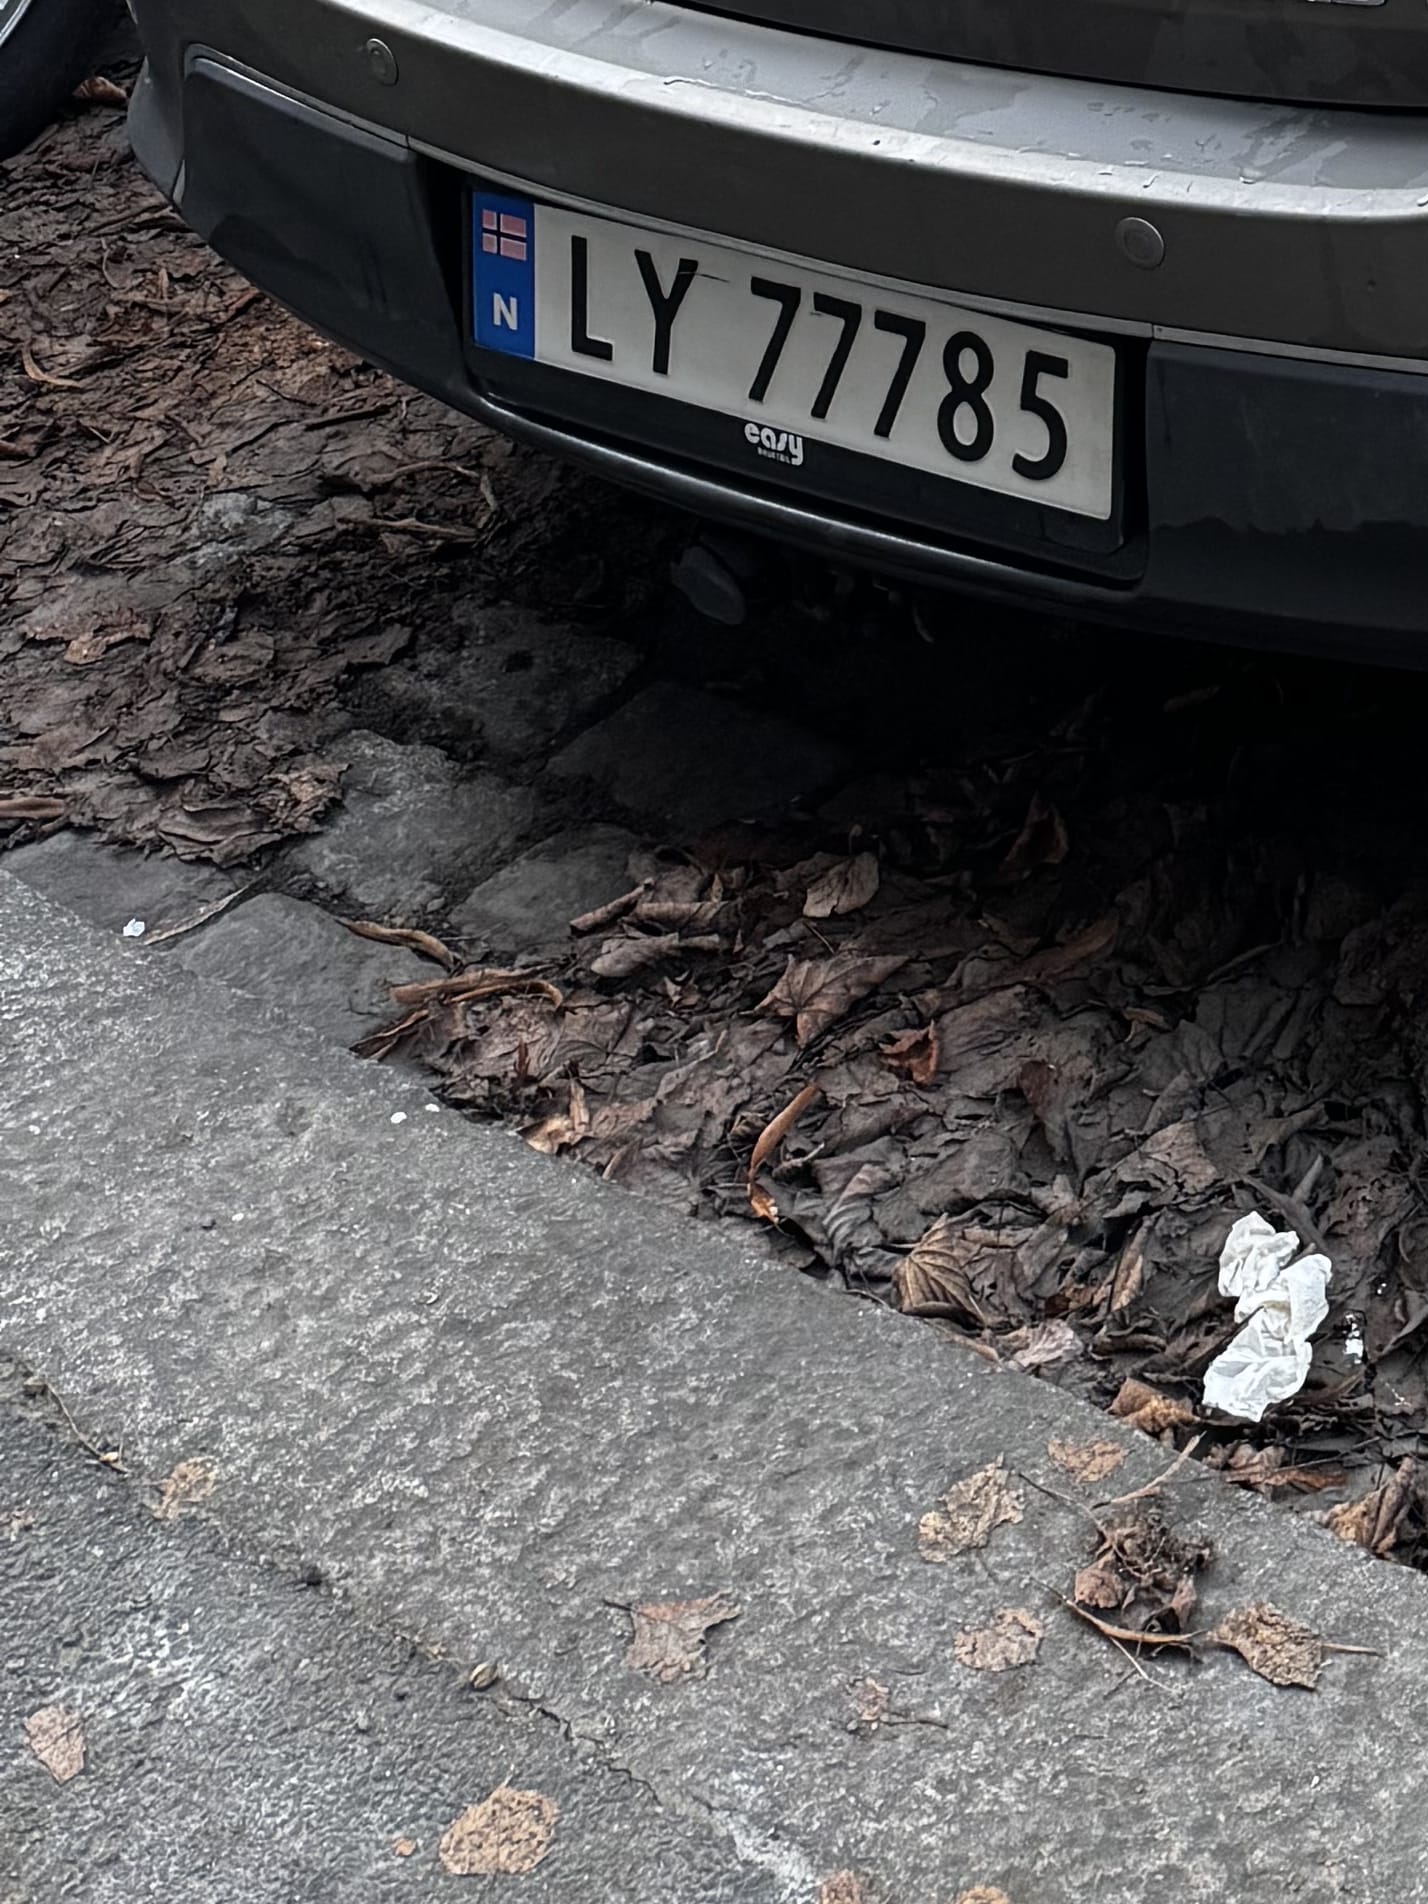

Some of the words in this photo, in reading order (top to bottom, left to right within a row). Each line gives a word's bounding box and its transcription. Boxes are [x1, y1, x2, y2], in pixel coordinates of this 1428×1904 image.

[491, 292, 519, 331] N
[571, 234, 699, 376] LY
[748, 275, 1069, 481] 77785
[744, 423, 804, 466] easy
